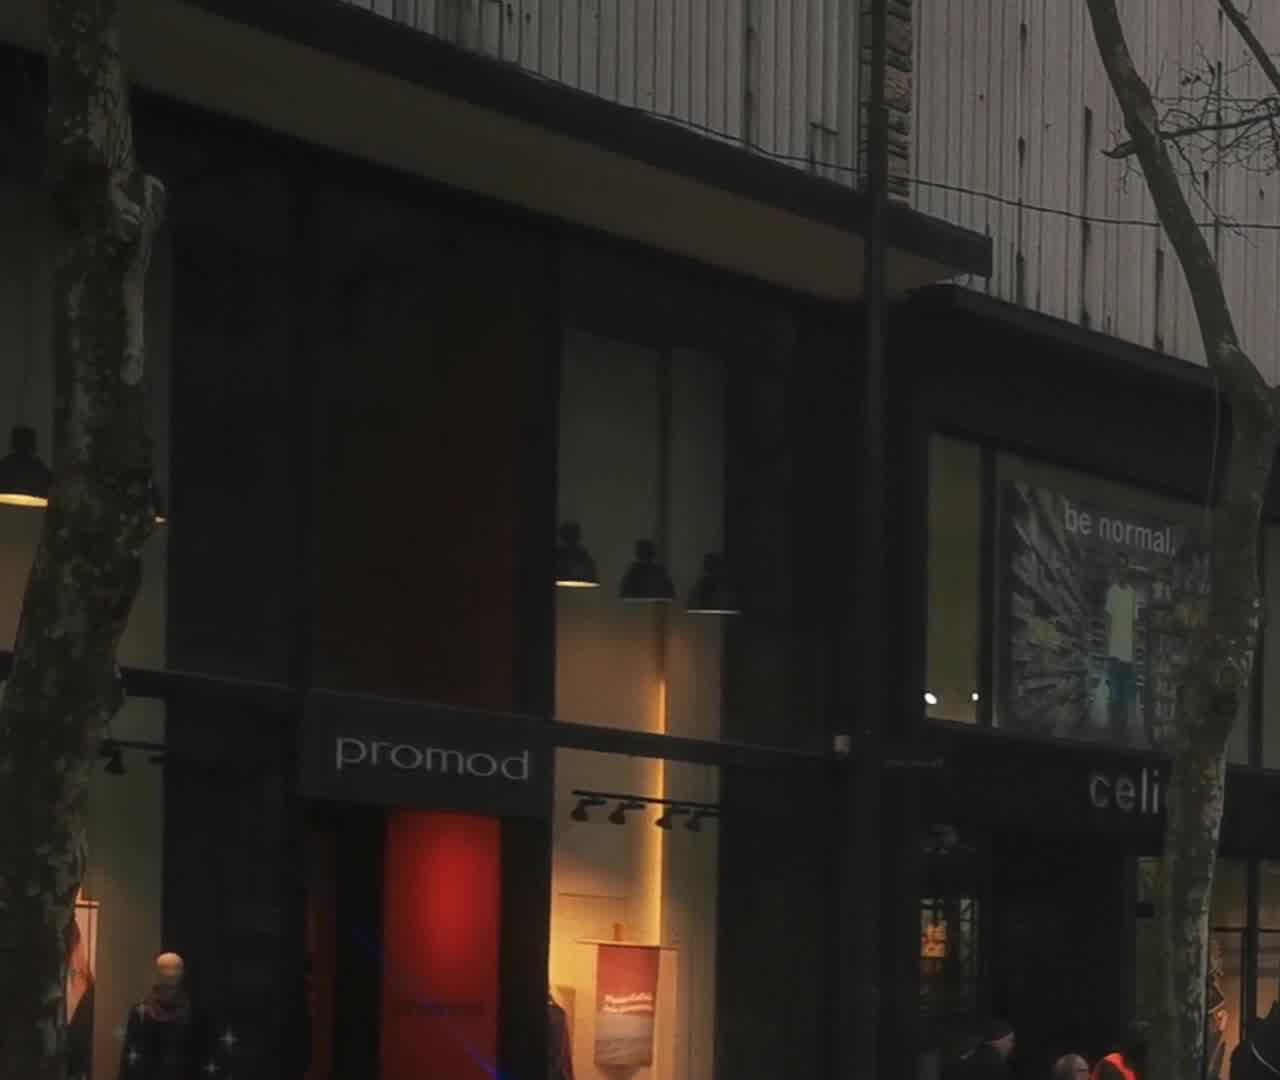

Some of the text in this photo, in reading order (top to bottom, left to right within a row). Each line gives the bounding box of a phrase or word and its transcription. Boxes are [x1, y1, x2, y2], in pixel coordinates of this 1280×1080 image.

[1064, 500, 1092, 536] be
[335, 736, 529, 781] promod
[1089, 767, 1163, 815] celi
